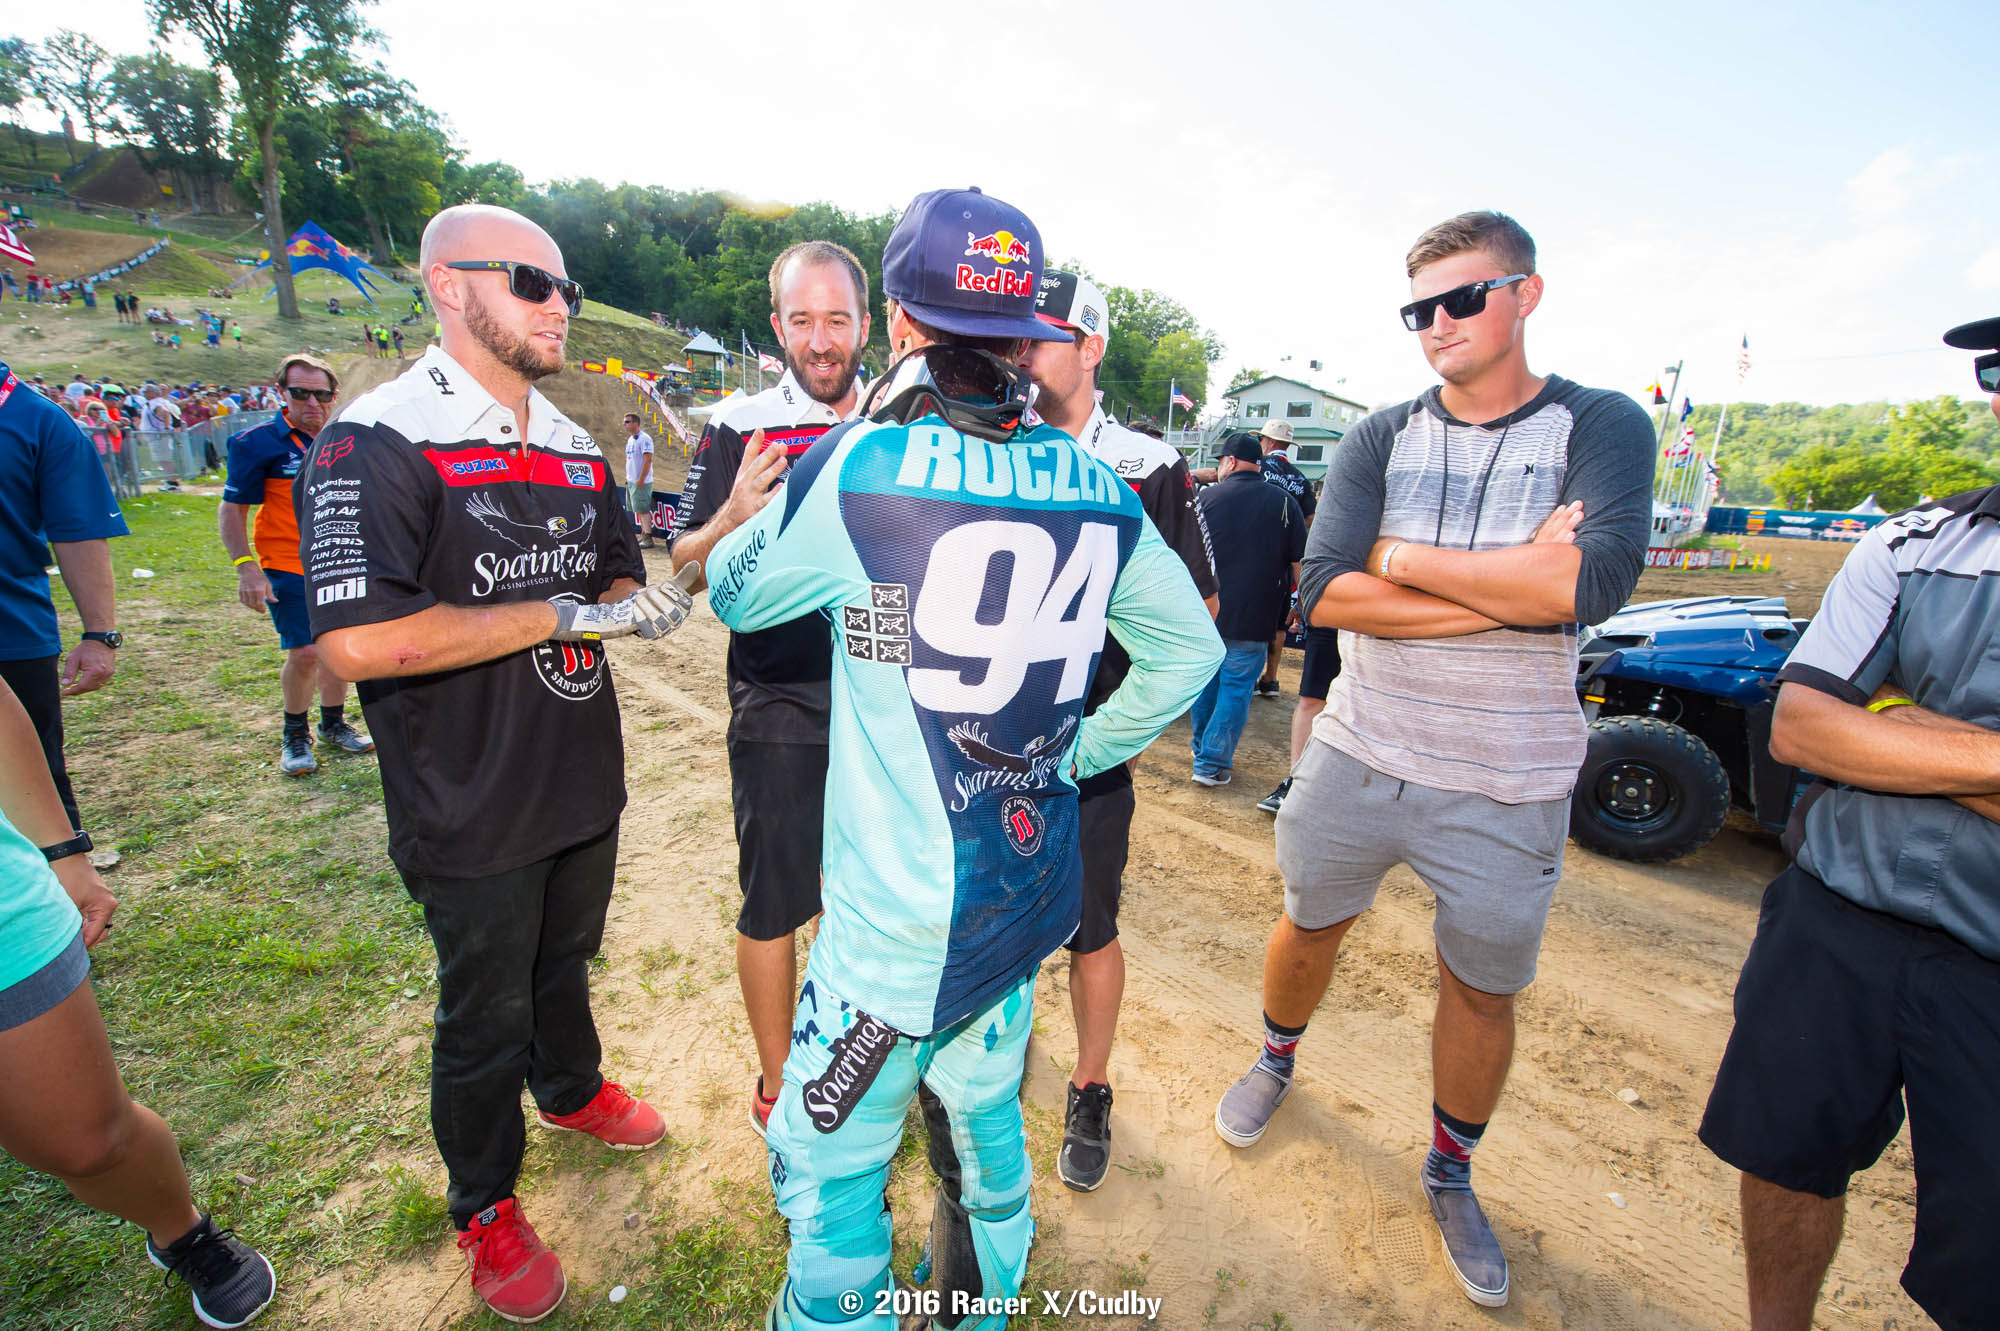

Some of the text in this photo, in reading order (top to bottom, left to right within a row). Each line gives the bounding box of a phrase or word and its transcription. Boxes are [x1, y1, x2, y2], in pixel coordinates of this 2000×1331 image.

[956, 264, 1033, 297] Red Bull
[1040, 277, 1061, 289] agle
[313, 506, 361, 521] Twin Air
[311, 538, 364, 551] ACERBIS
[728, 529, 766, 593] Eagle
[311, 559, 367, 572] DUNLOP
[908, 521, 1118, 714] 94
[951, 766, 1034, 812] Soaring
[1010, 809, 1034, 843] JJ
[806, 1022, 888, 1128] Soaring
